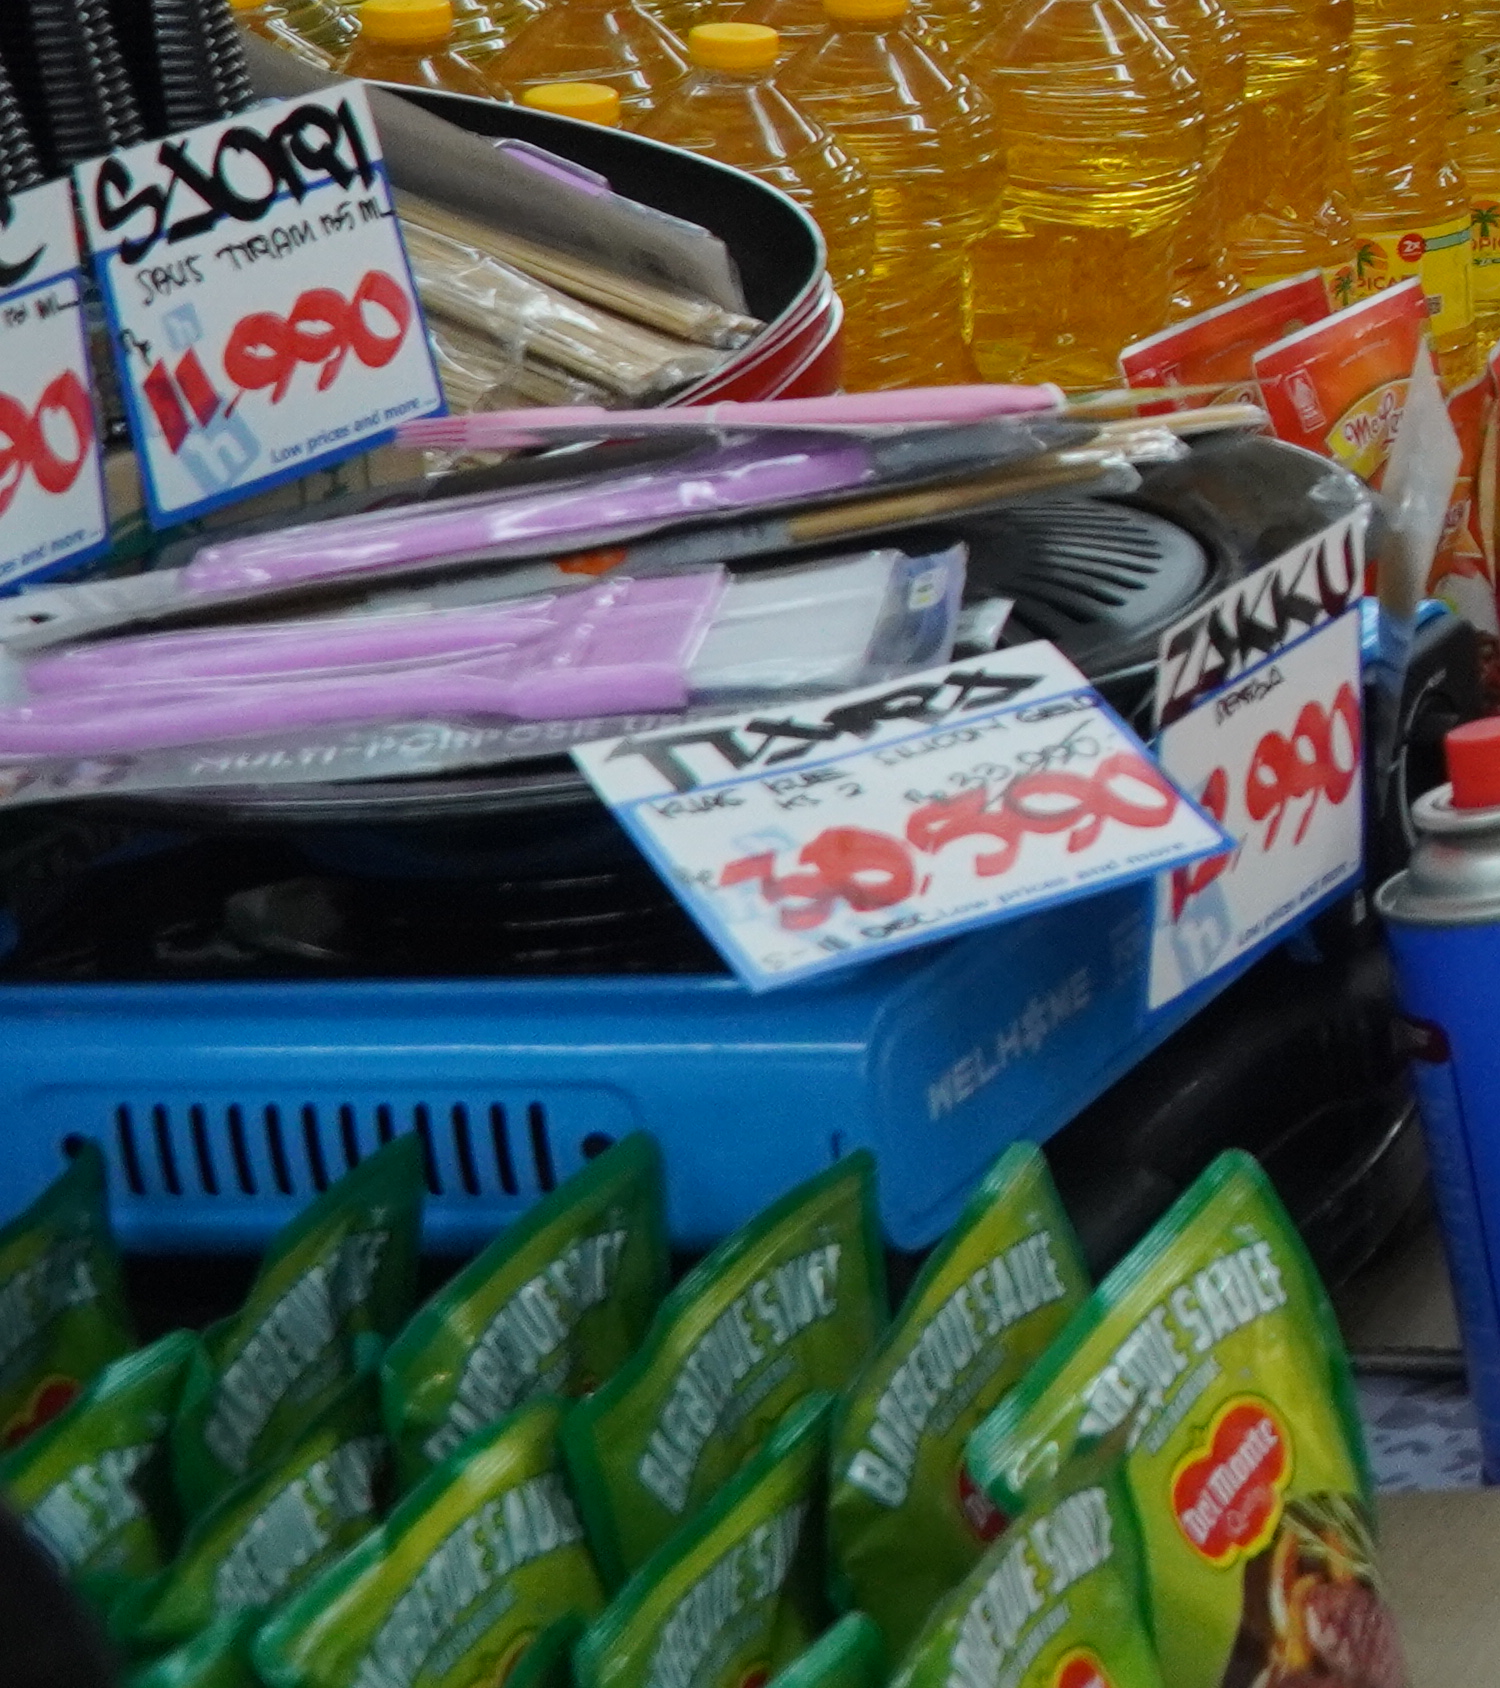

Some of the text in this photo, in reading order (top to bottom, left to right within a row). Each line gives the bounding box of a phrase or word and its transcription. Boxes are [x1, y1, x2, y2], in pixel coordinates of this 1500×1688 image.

[270, 397, 421, 464] Low prices and more
